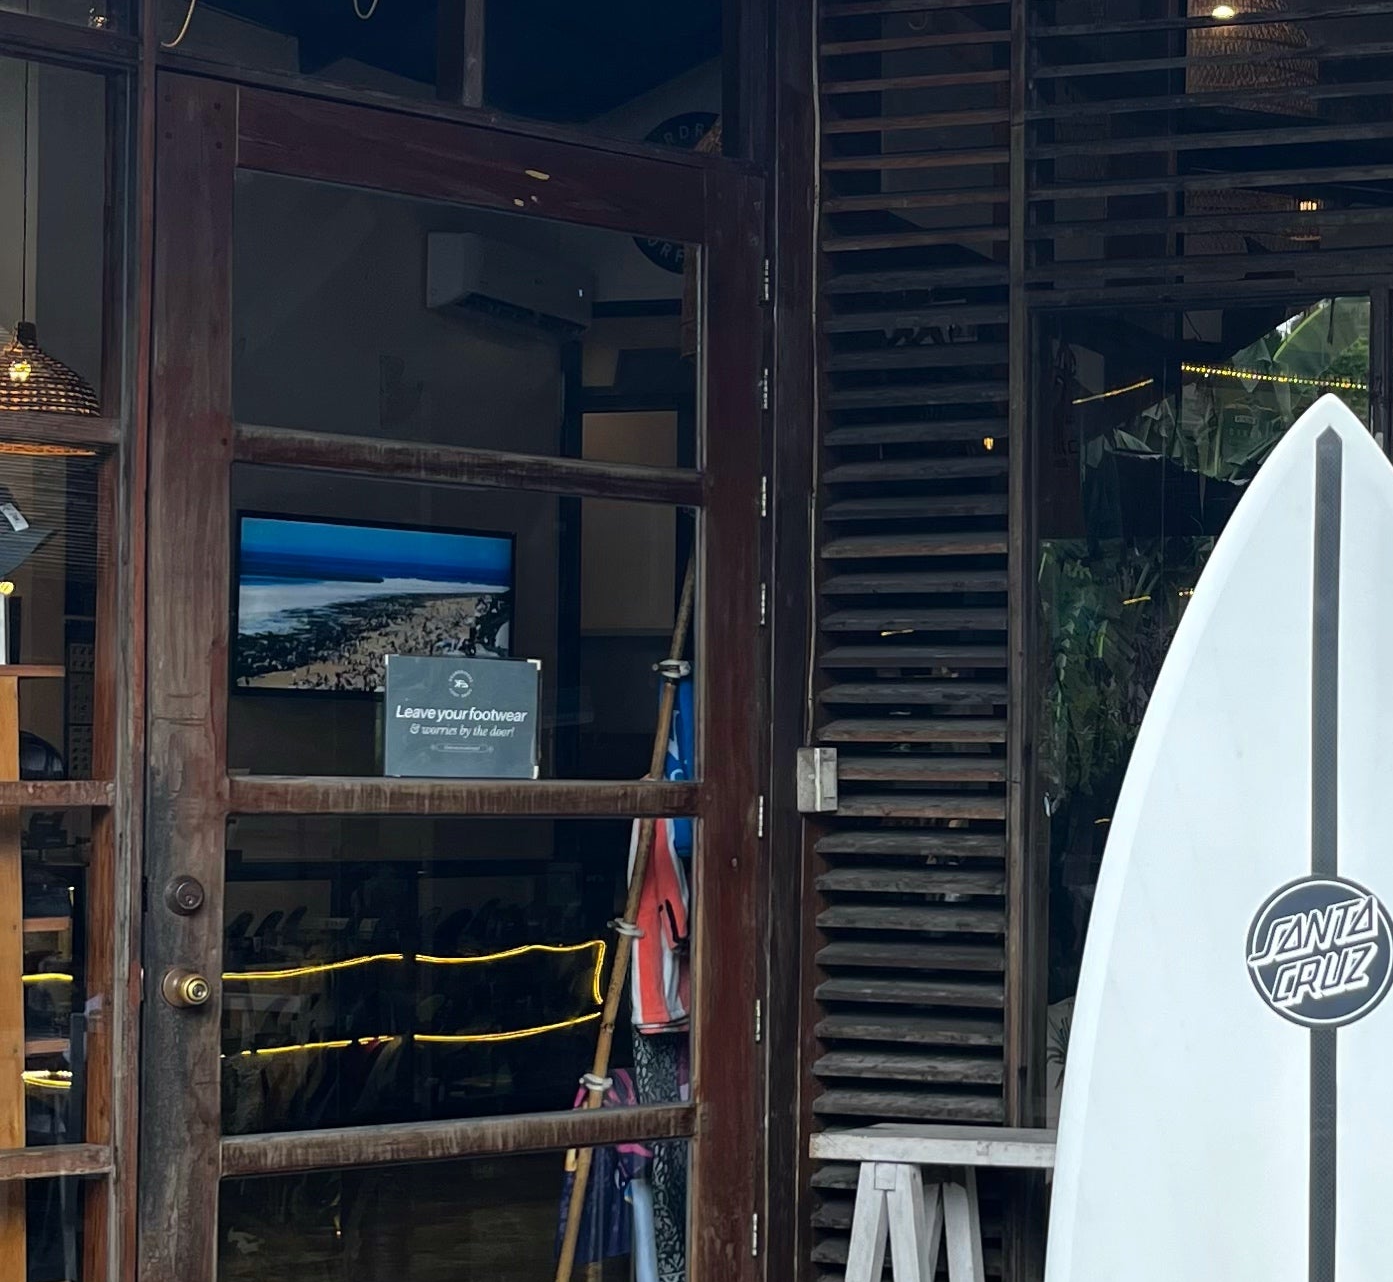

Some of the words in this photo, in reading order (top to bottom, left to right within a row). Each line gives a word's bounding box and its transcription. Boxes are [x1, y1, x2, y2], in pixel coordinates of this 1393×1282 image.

[396, 705, 436, 719] Leave
[436, 709, 469, 723] your
[469, 707, 527, 723] footwear
[421, 725, 457, 735] worries
[460, 724, 472, 739] by
[473, 725, 488, 737] the
[490, 725, 515, 738] door!
[1248, 895, 1378, 968] SANTA
[1270, 941, 1378, 1008] CRUZ
